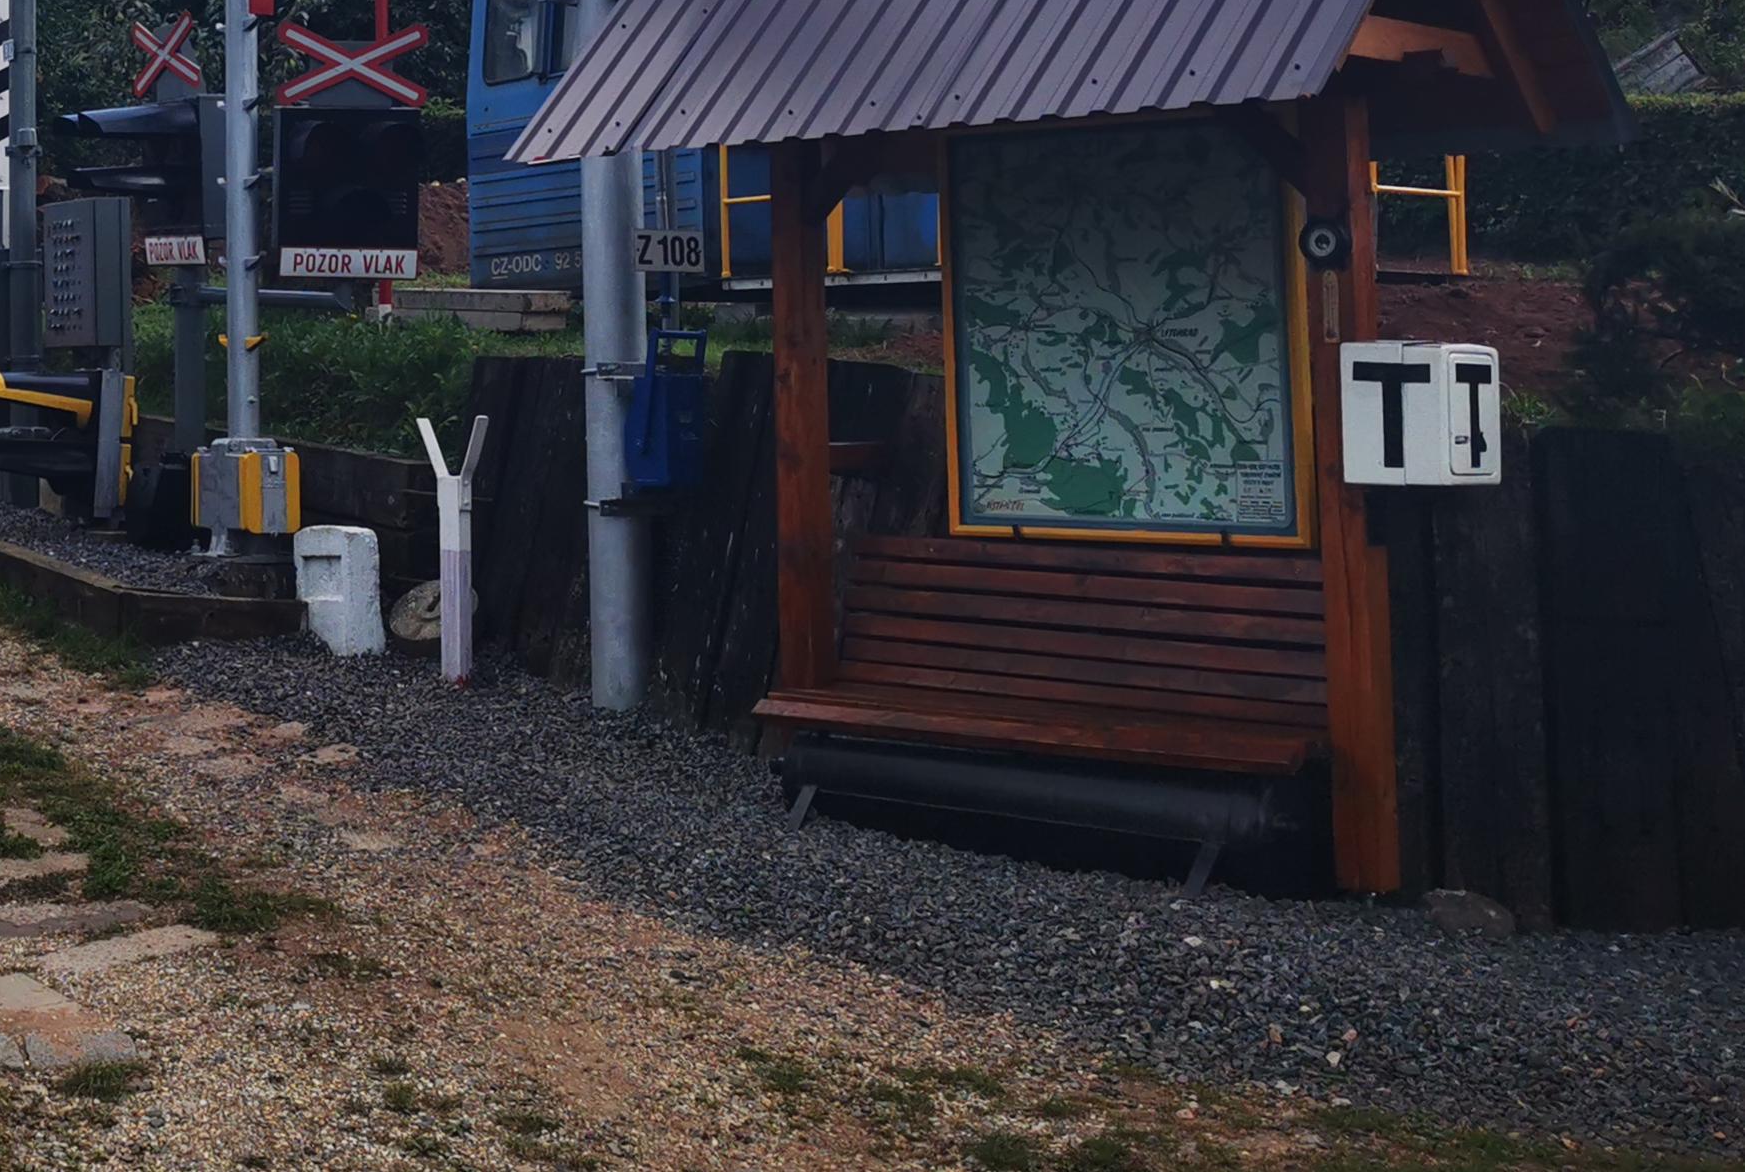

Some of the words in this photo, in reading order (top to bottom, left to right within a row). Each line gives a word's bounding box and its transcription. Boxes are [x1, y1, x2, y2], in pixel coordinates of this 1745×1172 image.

[149, 241, 176, 262] POZOR
[177, 240, 200, 261] VLAK
[637, 235, 653, 266] Z
[657, 234, 702, 267] 108
[294, 252, 352, 274] POZOR
[363, 253, 405, 275] VLAK
[491, 254, 542, 276] CZ-ODC
[555, 252, 571, 271] 92
[1353, 361, 1431, 468] T
